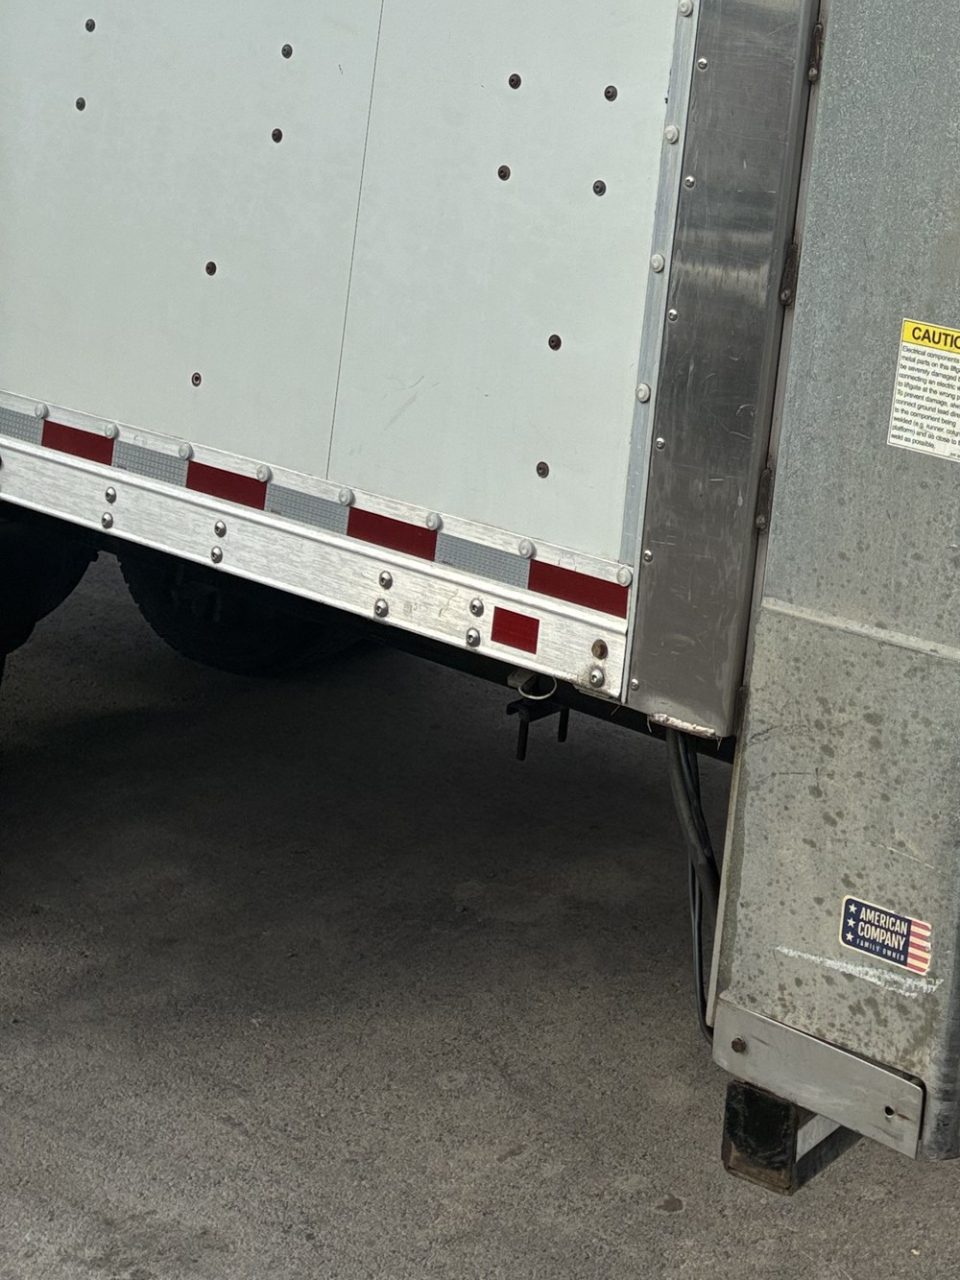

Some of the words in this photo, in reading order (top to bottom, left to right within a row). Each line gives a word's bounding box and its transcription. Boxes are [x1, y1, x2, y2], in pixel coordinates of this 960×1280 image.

[901, 354, 915, 362] metal
[916, 357, 930, 367] parts
[902, 345, 925, 356] Electrical
[926, 351, 959, 365] components
[898, 371, 927, 384] connecting
[930, 369, 956, 382] damaged
[938, 391, 955, 400] wrong
[895, 397, 916, 407] connect
[916, 402, 936, 413] ground
[909, 410, 940, 423] component
[940, 417, 956, 427] being
[916, 429, 926, 437] and
[860, 907, 908, 935] AMERICAN
[858, 922, 906, 951] COMPANY
[857, 939, 880, 951] FAMILY
